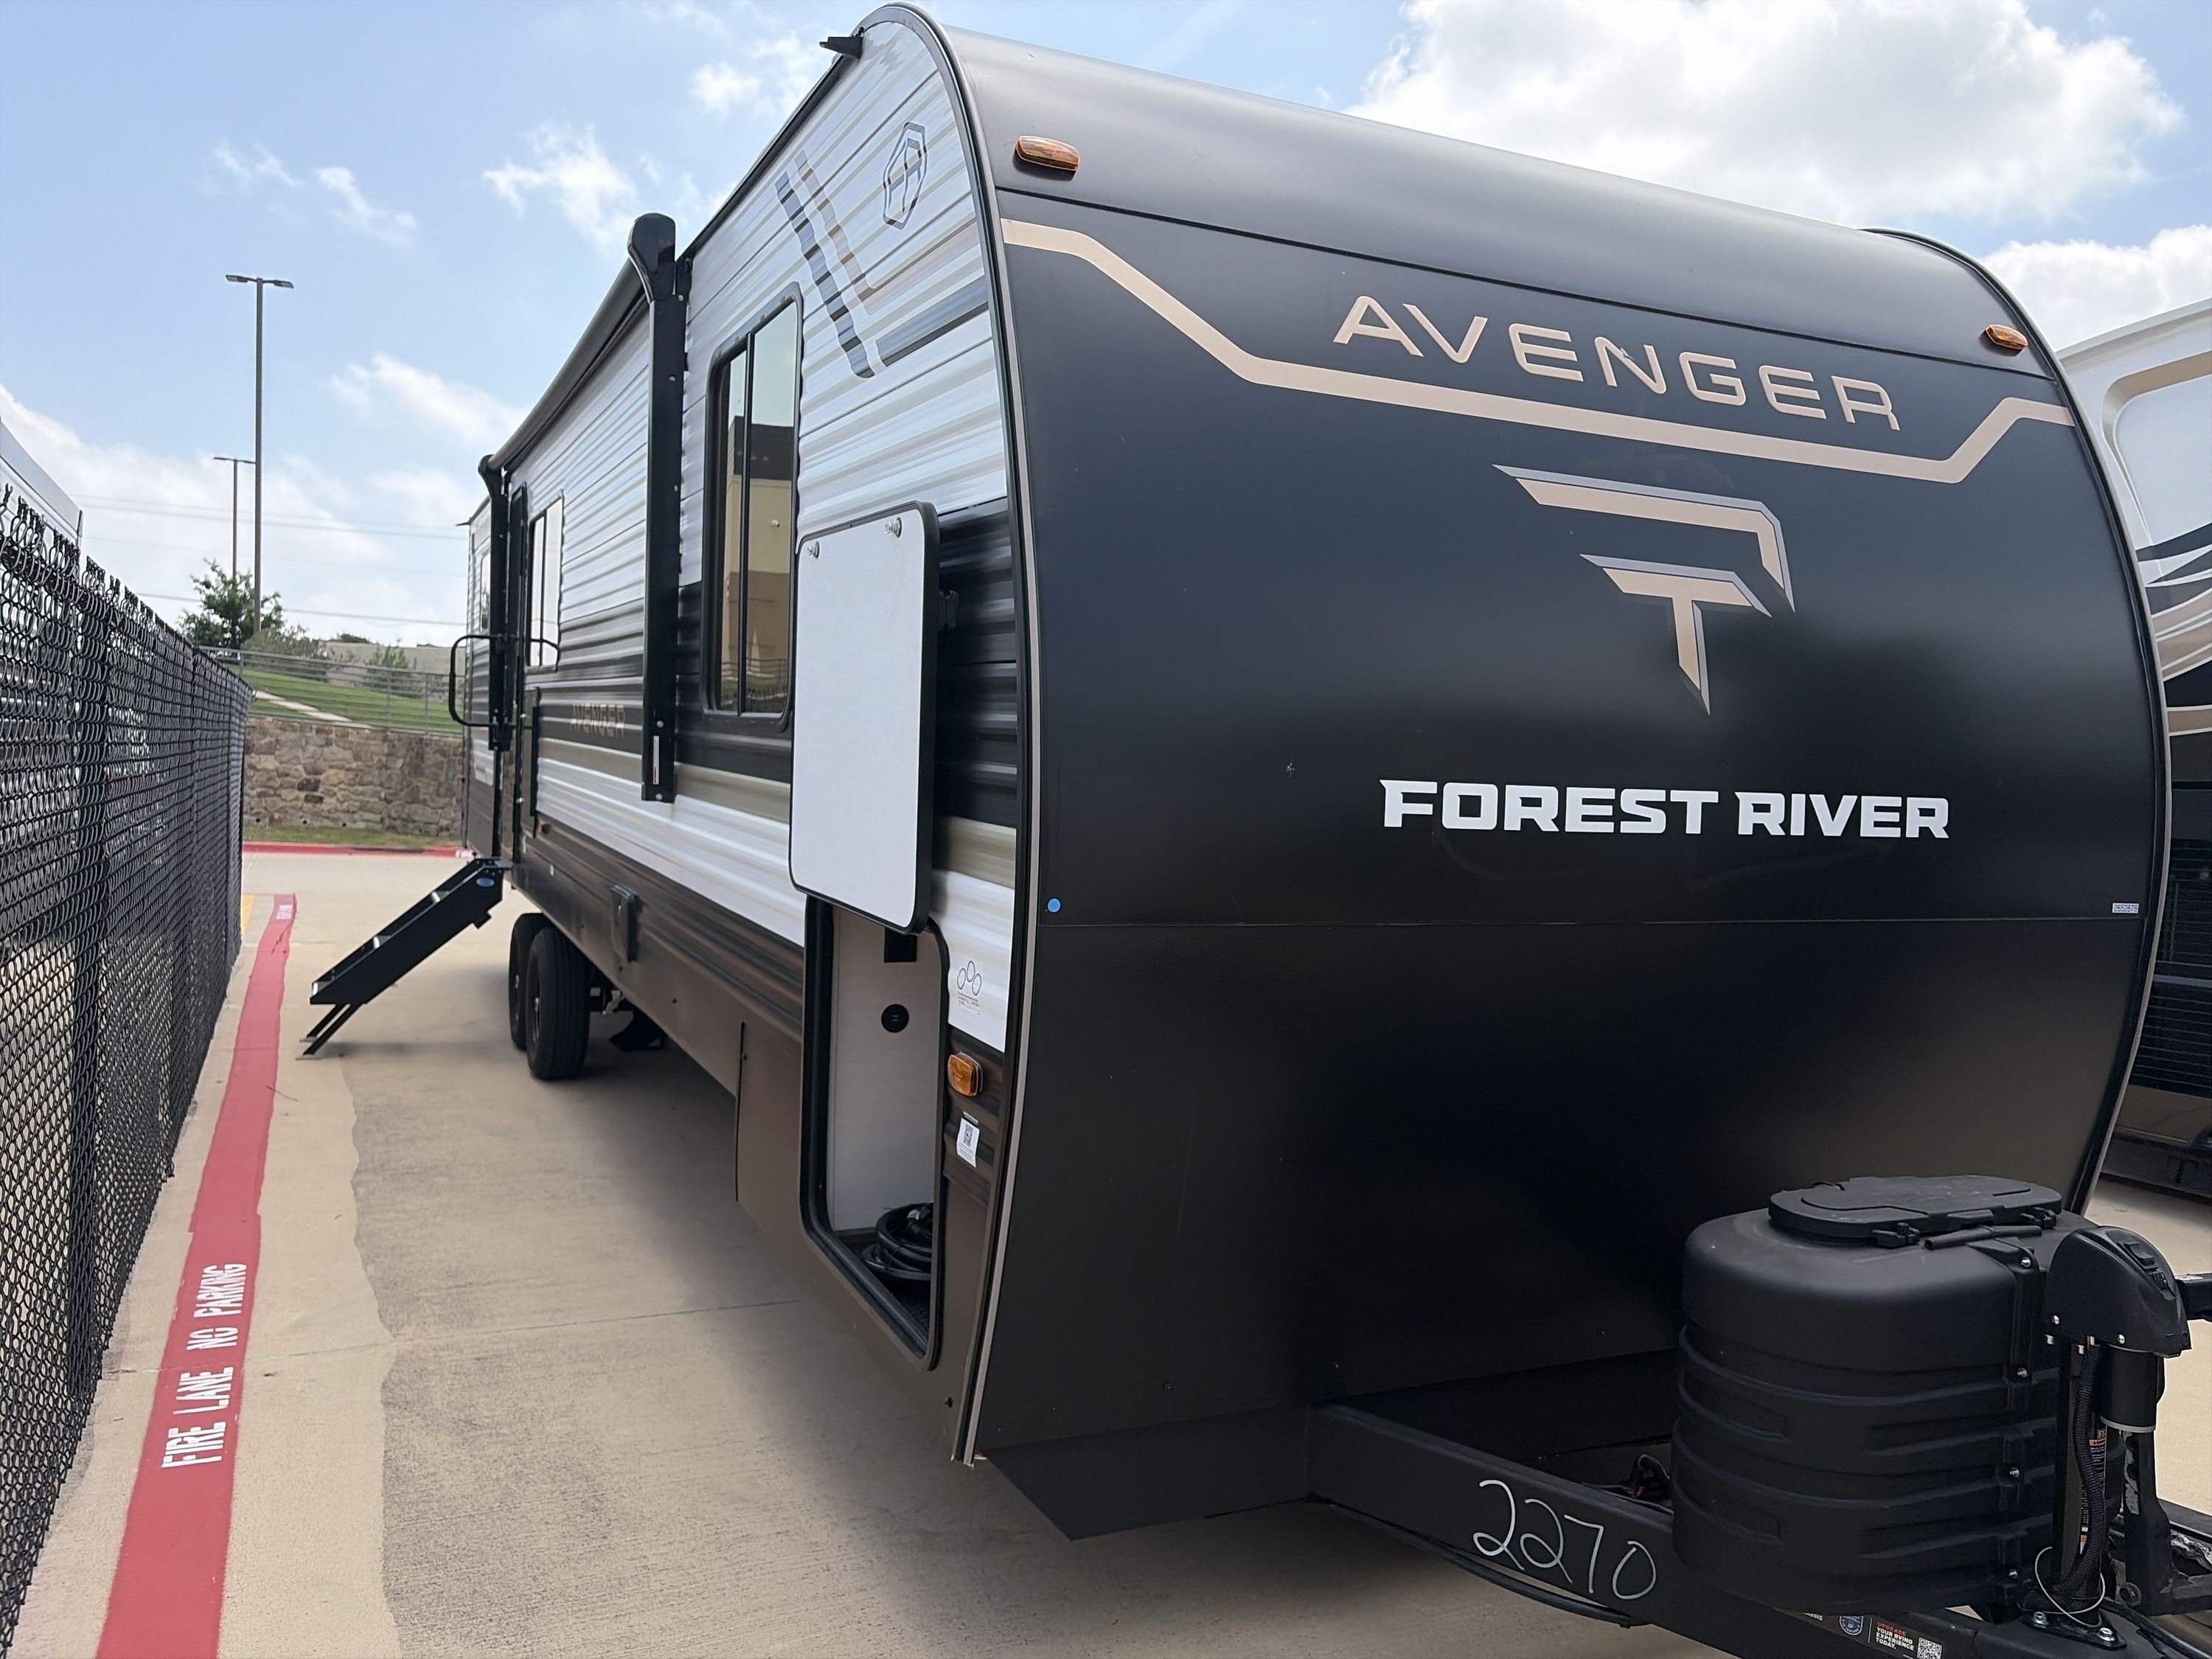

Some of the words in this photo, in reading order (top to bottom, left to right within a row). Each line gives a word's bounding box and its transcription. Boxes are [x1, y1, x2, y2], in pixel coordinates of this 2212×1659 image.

[1332, 294, 1900, 431] AVENGER
[570, 703, 625, 739] AVENGER
[1379, 779, 1719, 835] FOREST
[1735, 791, 1950, 838] RIVER
[193, 1263, 248, 1318] PARKING
[187, 1326, 238, 1350] NO
[173, 1366, 234, 1415] LANE
[161, 1422, 226, 1468] FIRE
[1473, 1480, 1656, 1599] 2270
[1875, 1637, 1896, 1649] TODAY.
[1876, 1632, 1915, 1651] EXPERIENCE
[1877, 1627, 1893, 1637] YOUR
